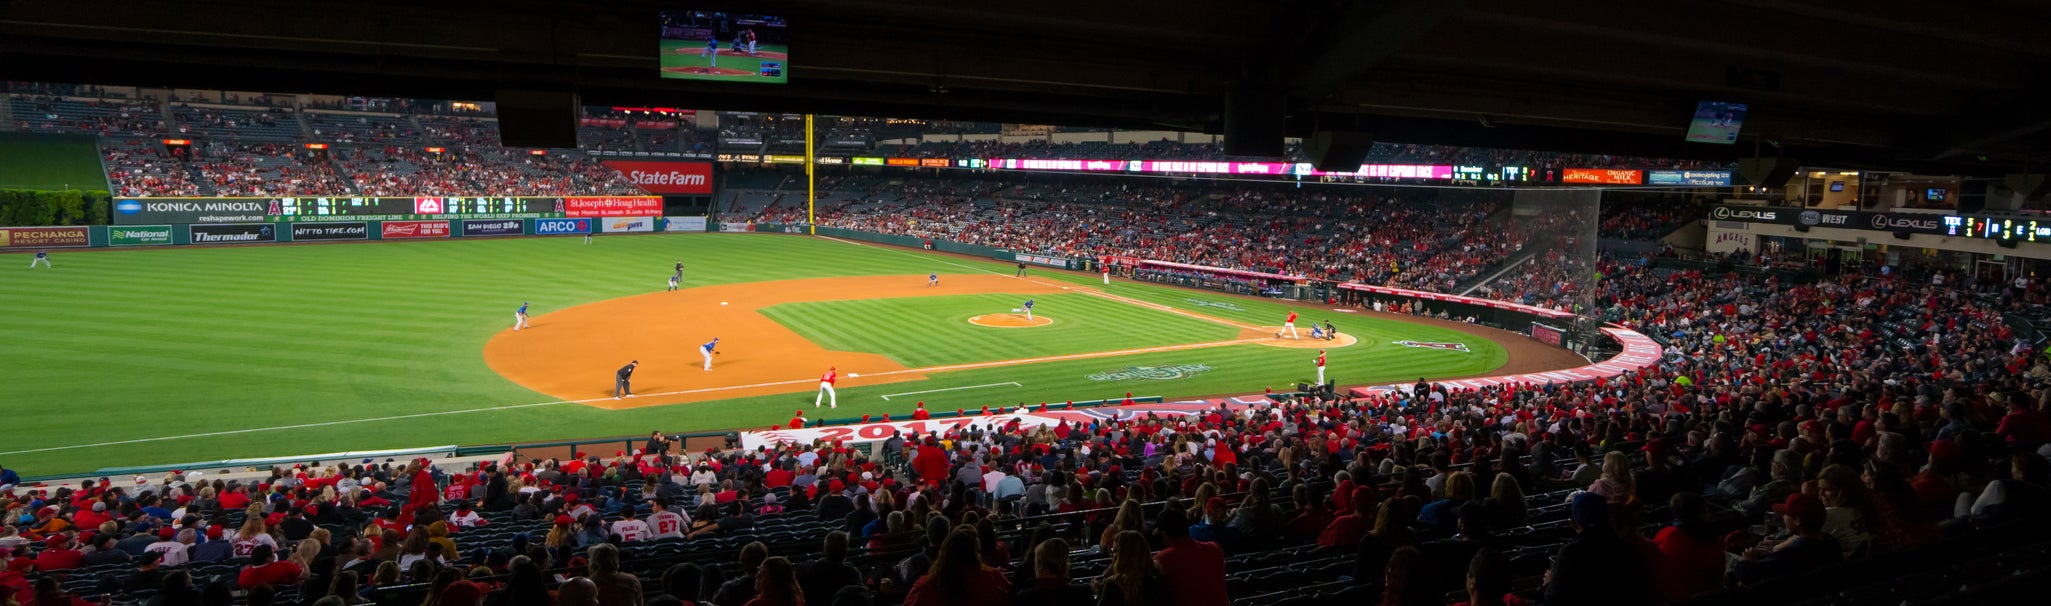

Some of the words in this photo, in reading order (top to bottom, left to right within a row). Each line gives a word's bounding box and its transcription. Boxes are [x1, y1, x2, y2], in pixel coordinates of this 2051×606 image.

[630, 170, 667, 186] State
[669, 171, 705, 185] Farm
[147, 202, 202, 212] KONICA
[204, 202, 263, 212] MINOLTA
[613, 199, 633, 208] Hoag
[633, 199, 657, 207] Health
[199, 214, 263, 222] reshapework.com
[1731, 210, 1776, 220] LEXUS
[1822, 214, 1848, 225] WEST
[539, 221, 576, 232] ARCO
[613, 221, 643, 231] ampm
[1888, 217, 1938, 229] LEXUS
[1944, 216, 1962, 226] TEX
[1967, 217, 1974, 226] 5
[1977, 222, 1984, 231] 7
[1991, 223, 1999, 233] H
[2004, 219, 2011, 229] 9
[2016, 225, 2023, 235] E
[2029, 221, 2037, 230] 2
[14, 230, 84, 239] PECHANGA
[125, 230, 169, 239] National
[295, 227, 322, 235] NITTO
[326, 226, 365, 234] TIRE.COM
[1966, 228, 1973, 237] 1
[2002, 230, 2010, 239] 3
[2028, 231, 2035, 241] 1
[194, 231, 259, 242] Thermador
[1716, 232, 1748, 246] ANGELS
[816, 418, 973, 442] 2017
[658, 519, 677, 534] 27
